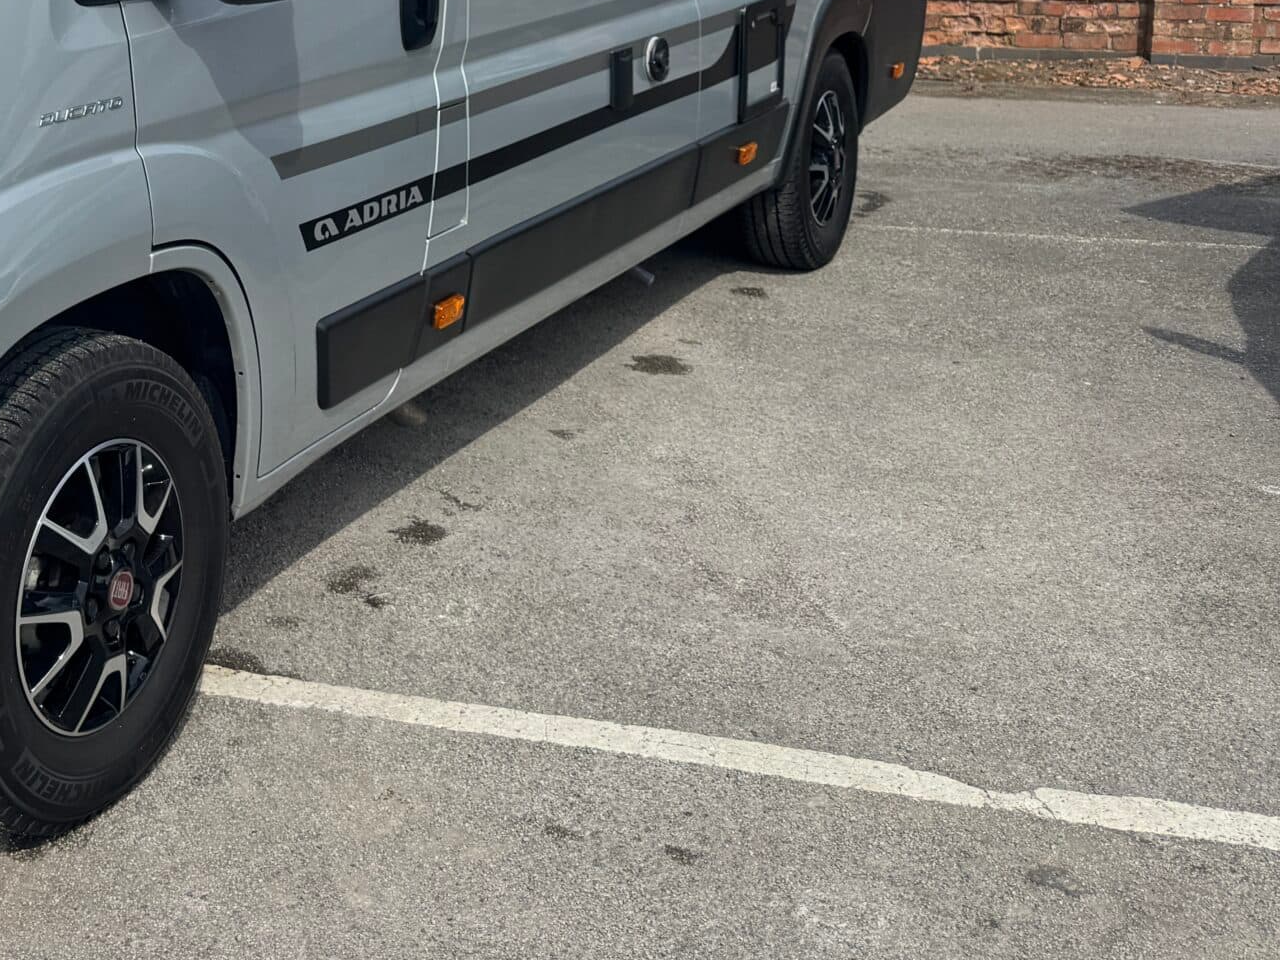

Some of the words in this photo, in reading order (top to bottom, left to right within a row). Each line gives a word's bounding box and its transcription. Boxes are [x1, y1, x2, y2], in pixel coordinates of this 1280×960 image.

[39, 96, 123, 128] DUCATO
[344, 185, 424, 232] ADRIA
[123, 380, 202, 438] MICHELIN
